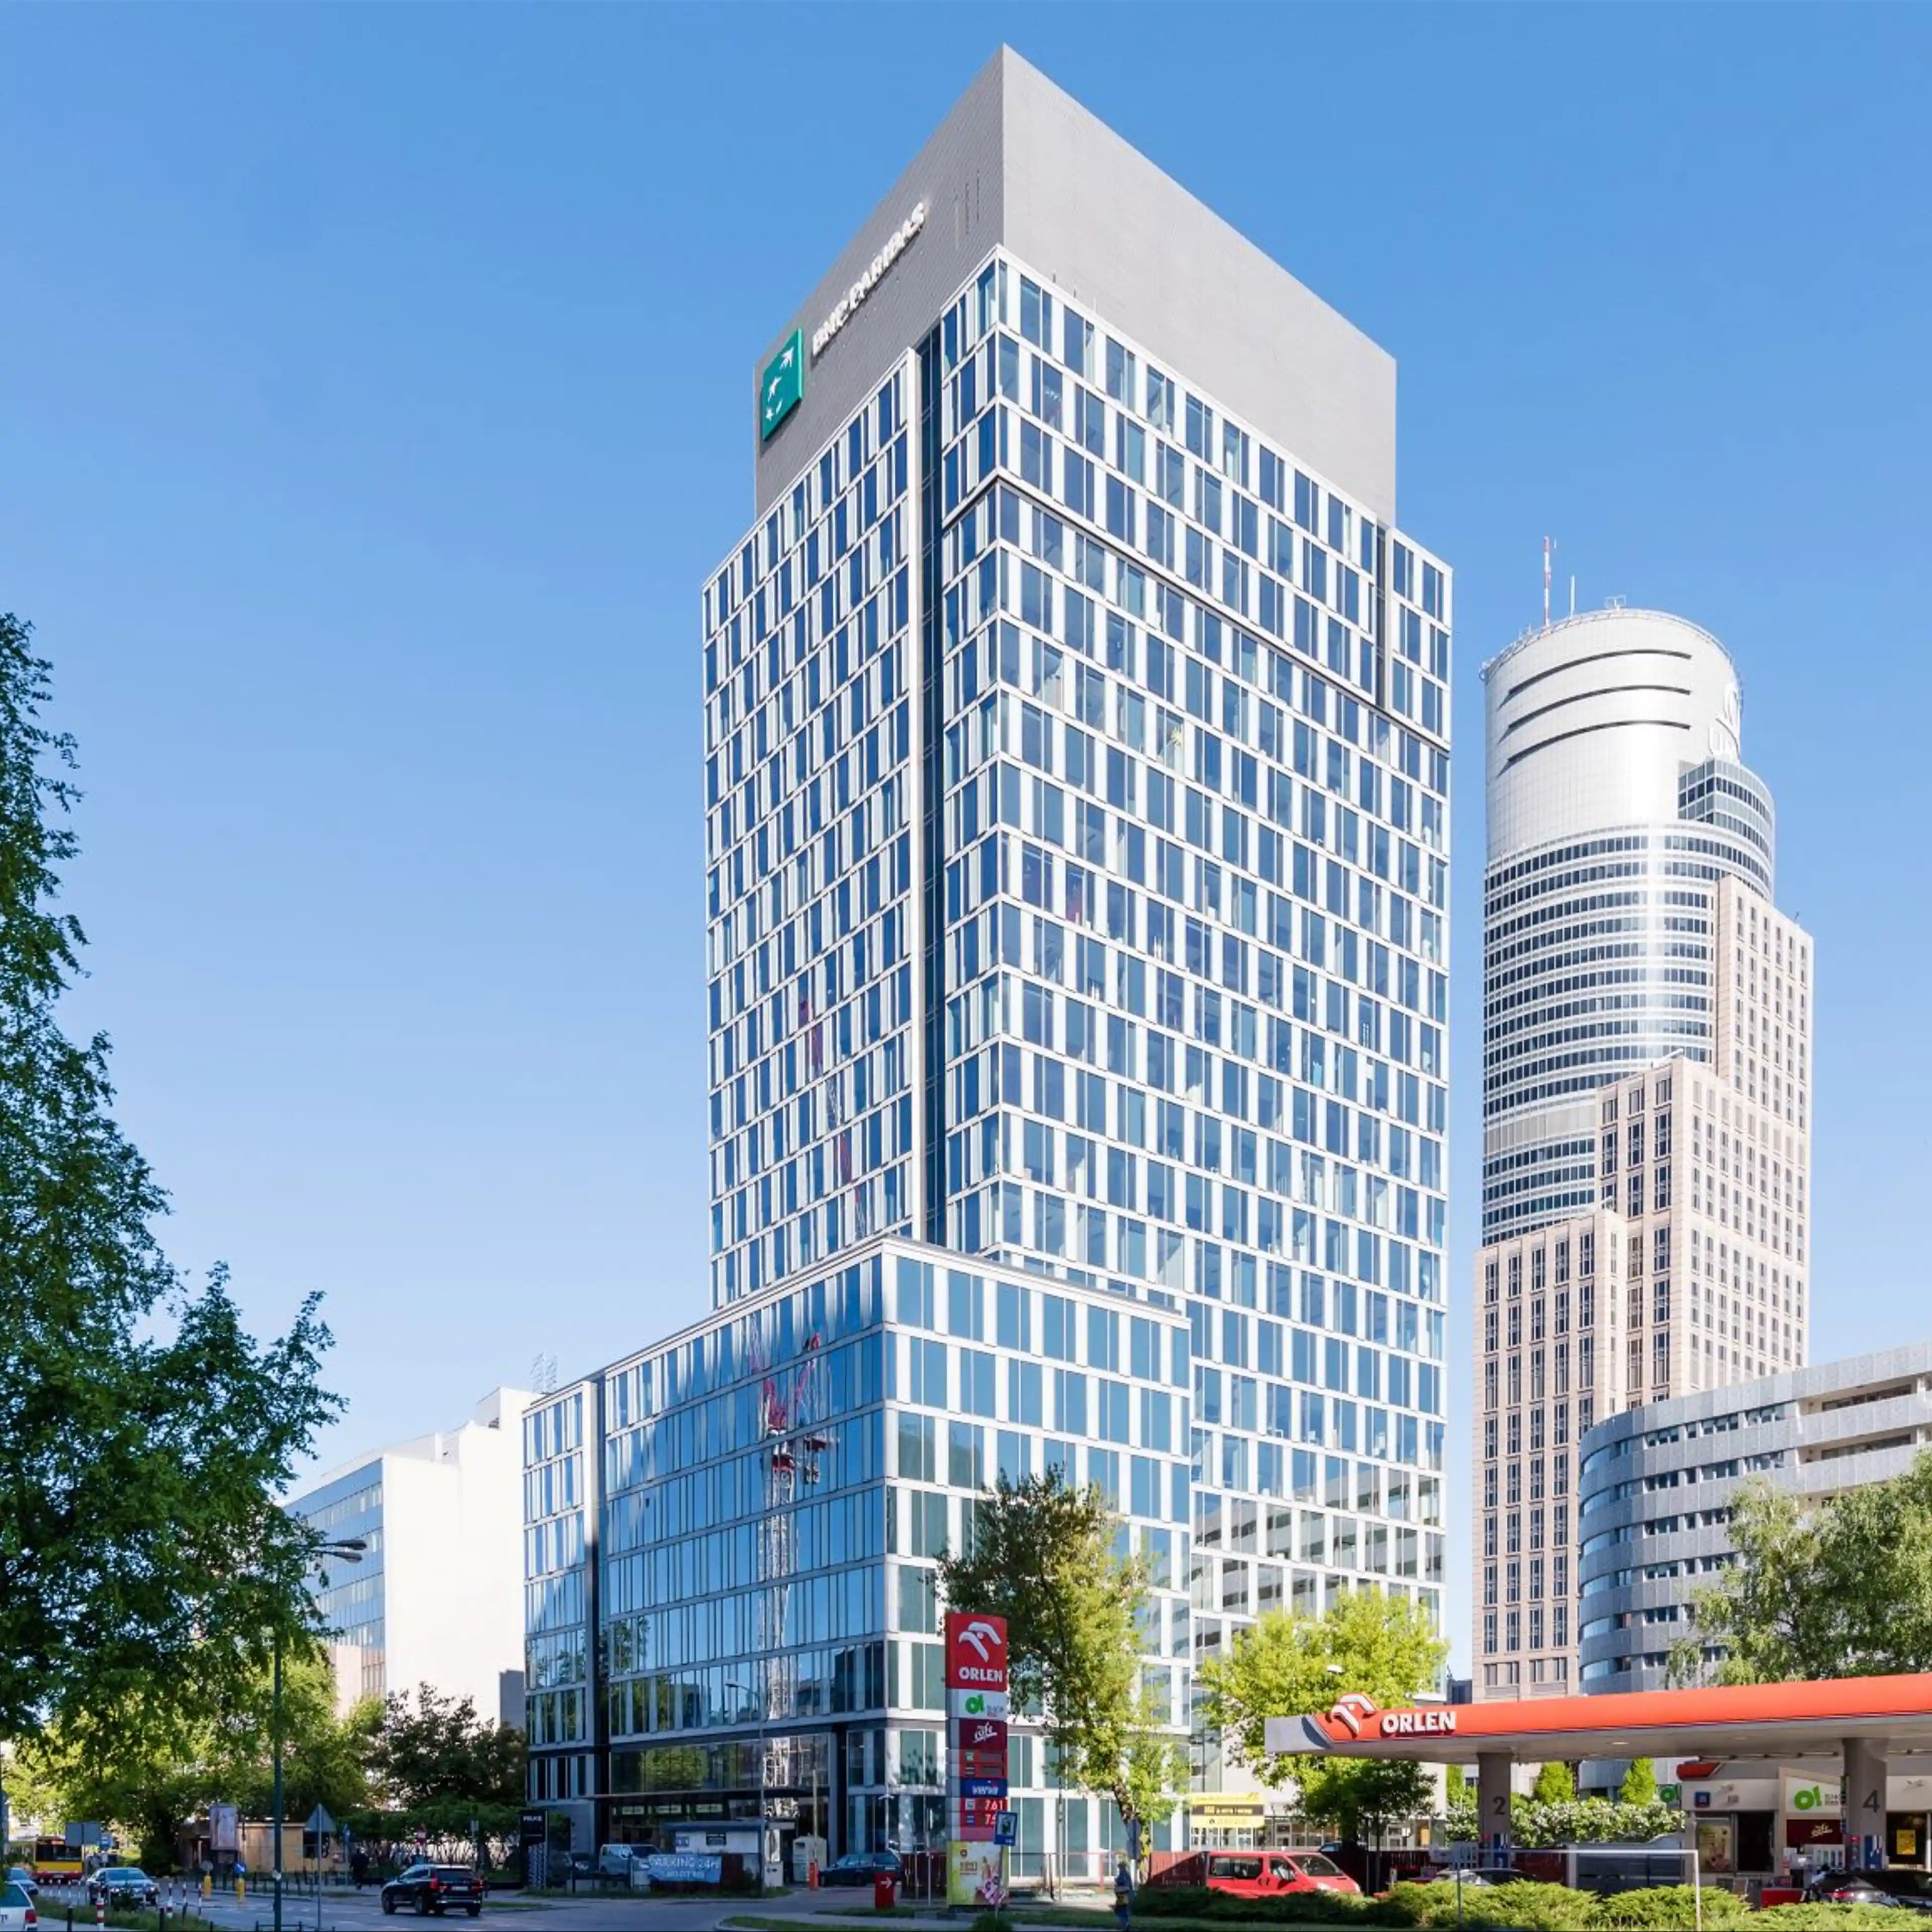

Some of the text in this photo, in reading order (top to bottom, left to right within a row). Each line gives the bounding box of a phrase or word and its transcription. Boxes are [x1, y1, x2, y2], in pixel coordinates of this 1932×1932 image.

[812, 202, 925, 357] BNP PARIBAS
[958, 1667, 1003, 1682] ORLEN
[1382, 1711, 1456, 1733] ORLEN
[1492, 1795, 1506, 1815] 2
[1862, 1790, 1880, 1813] 4
